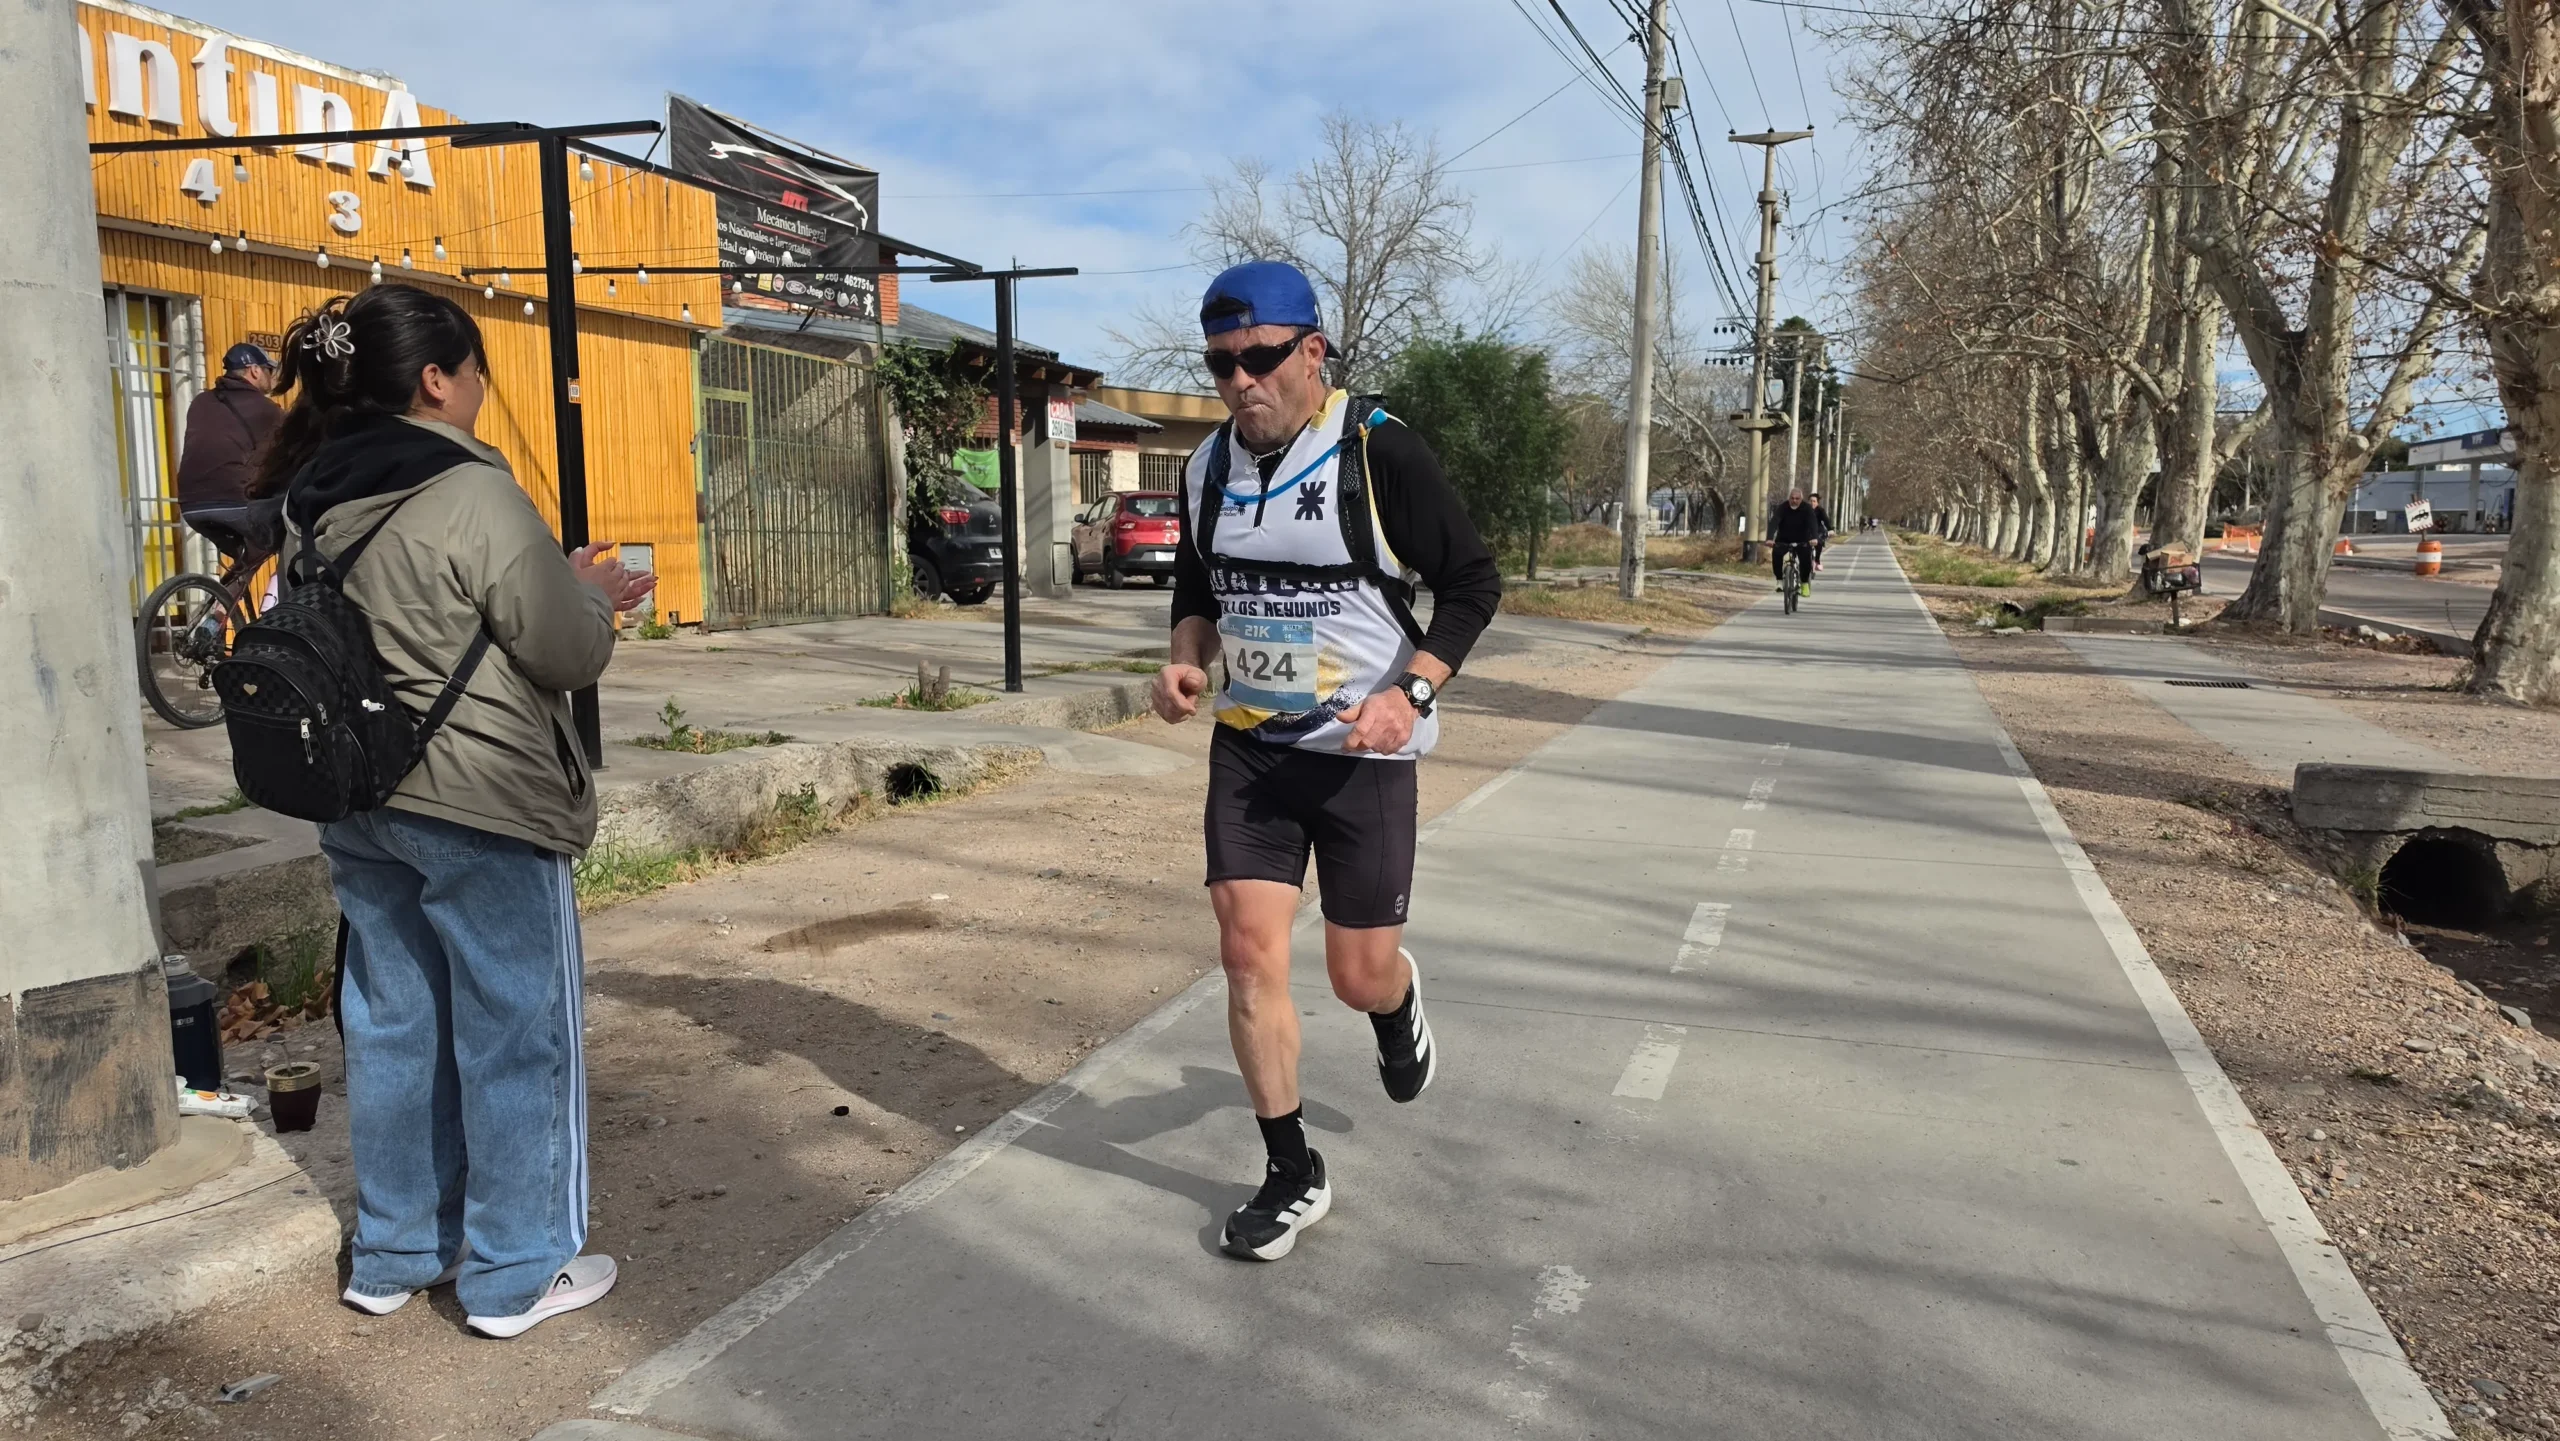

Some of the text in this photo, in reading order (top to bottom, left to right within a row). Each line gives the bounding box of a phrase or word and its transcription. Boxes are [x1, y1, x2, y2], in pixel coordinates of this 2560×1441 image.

[181, 158, 363, 233] 4 3
[728, 221, 769, 244] Nacionales
[769, 236, 775, 246] e
[757, 206, 797, 233] Mecánica
[797, 219, 827, 244] Integral
[250, 333, 280, 348] 2503
[1264, 600, 1341, 618] REYUNOS
[1244, 624, 1271, 639] 21K
[1236, 647, 1298, 682] 424
